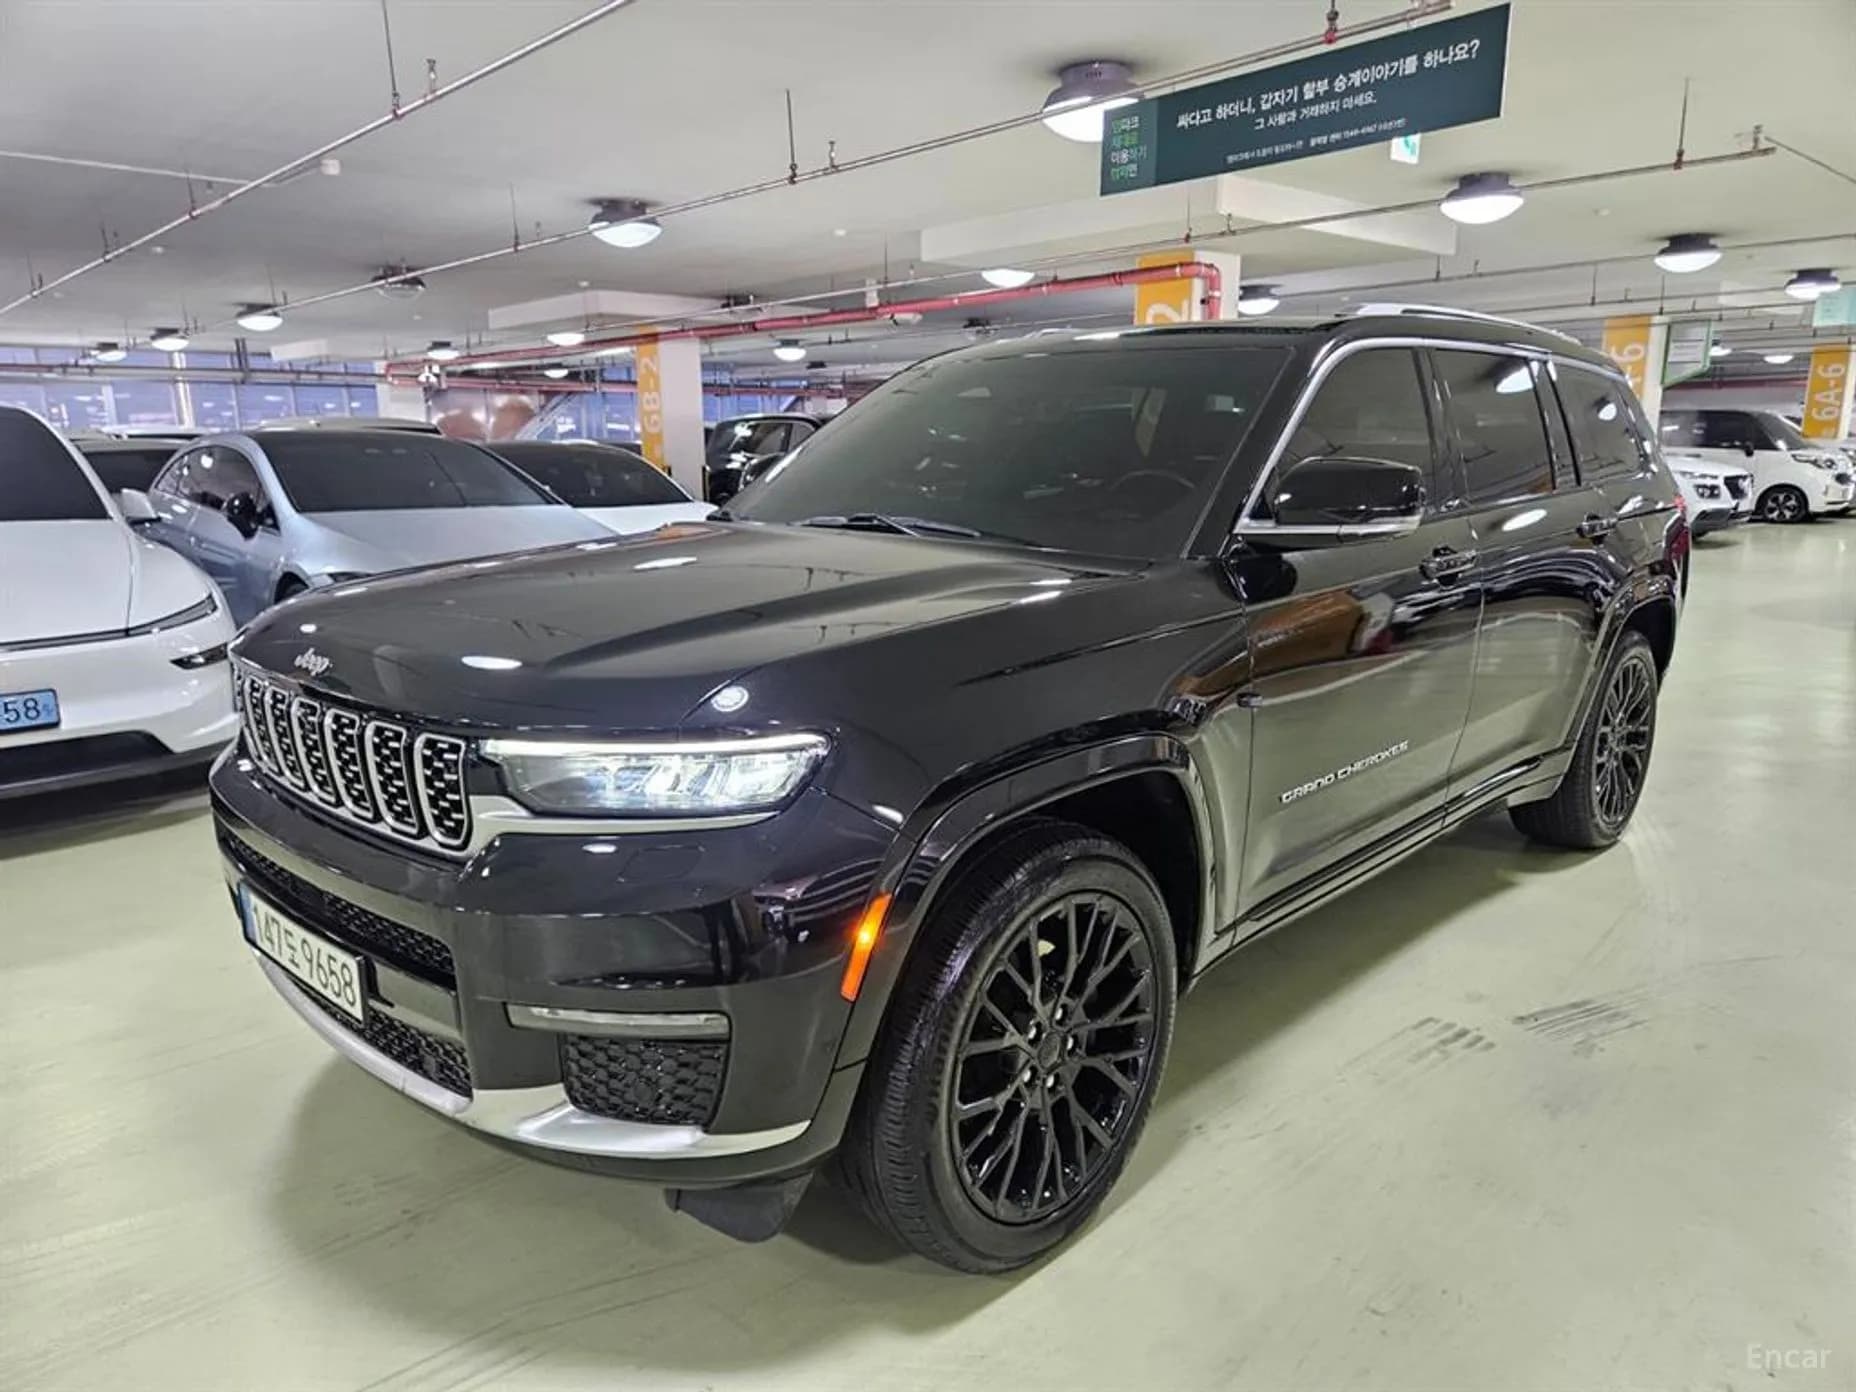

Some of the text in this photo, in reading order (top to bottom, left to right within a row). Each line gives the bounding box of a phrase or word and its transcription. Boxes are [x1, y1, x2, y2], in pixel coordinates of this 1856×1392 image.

[1176, 108, 1213, 129] 싸다고
[1216, 97, 1256, 119] 하더니,
[1260, 85, 1299, 110] 갑자기
[1423, 39, 1481, 69] 하나요?
[1254, 117, 1265, 130] 그
[1812, 362, 1846, 421] 6A-6
[1281, 740, 1409, 804] GRAND CHEROKEE
